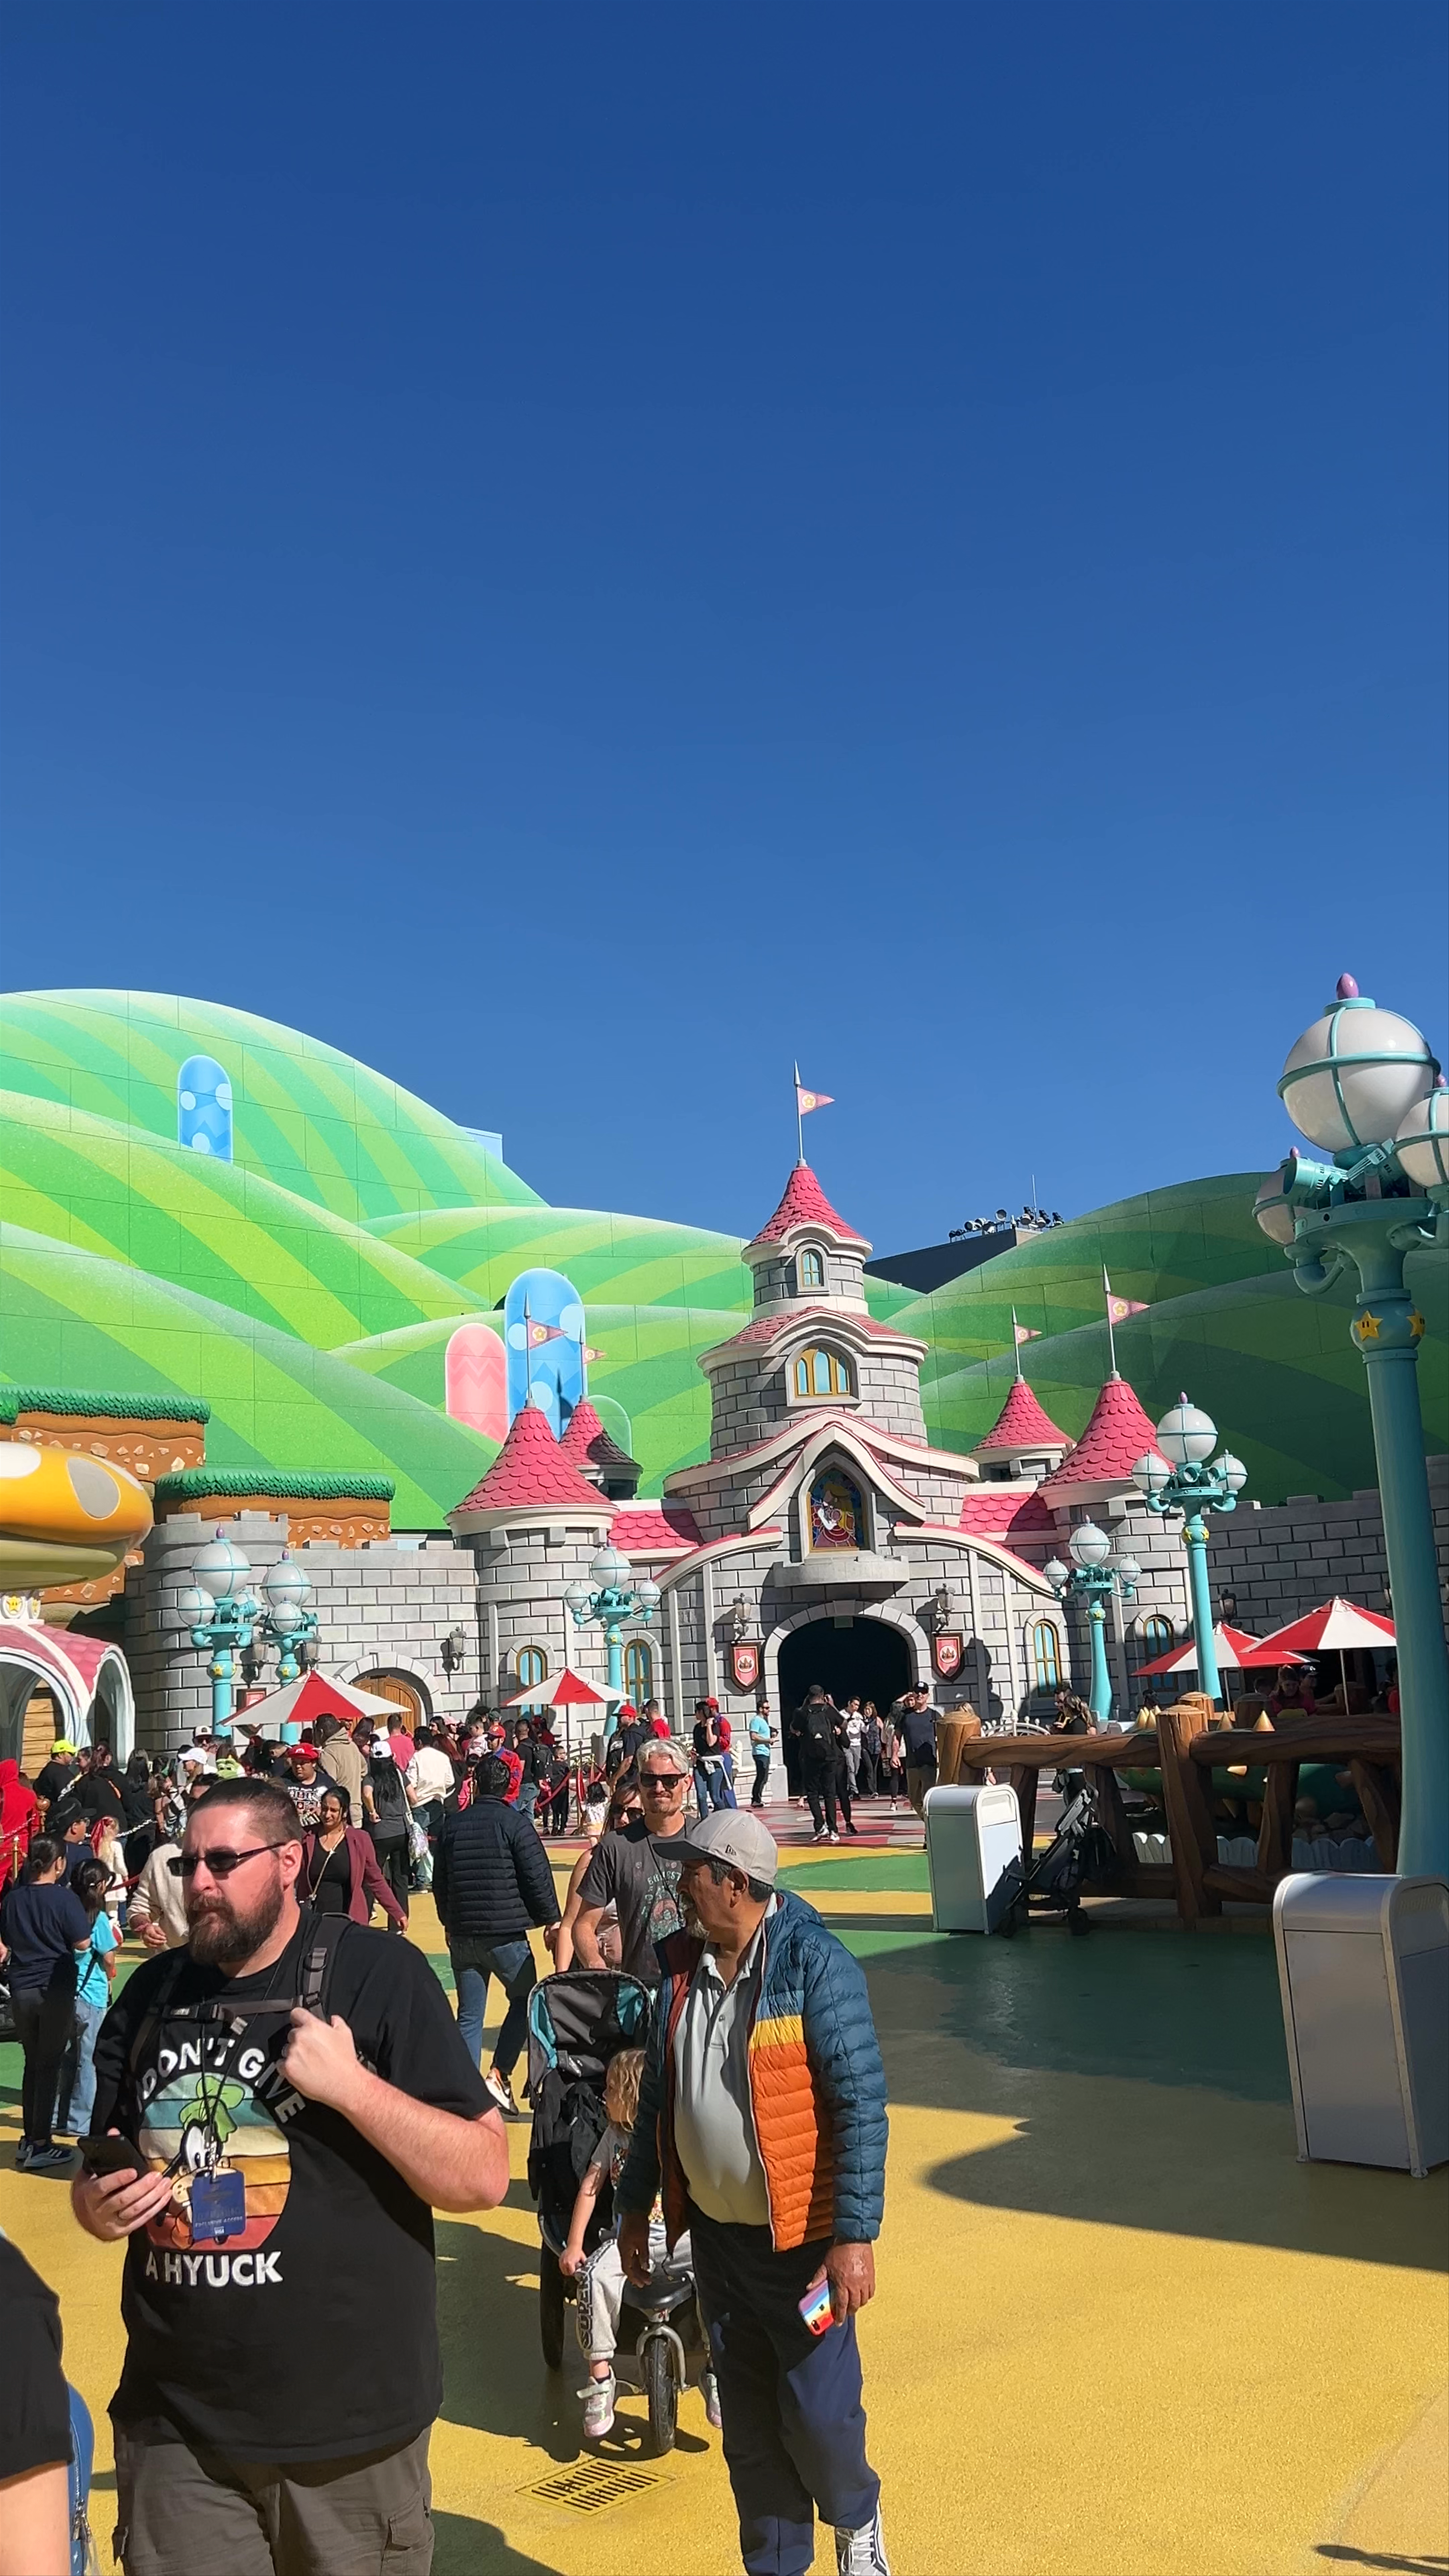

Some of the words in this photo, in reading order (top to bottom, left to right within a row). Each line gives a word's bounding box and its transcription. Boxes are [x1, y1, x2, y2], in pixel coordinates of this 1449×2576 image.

[142, 2038, 235, 2100] DON'T
[238, 2048, 306, 2124] GIVE
[146, 2251, 158, 2281] A
[165, 2251, 283, 2287] HYUCK
